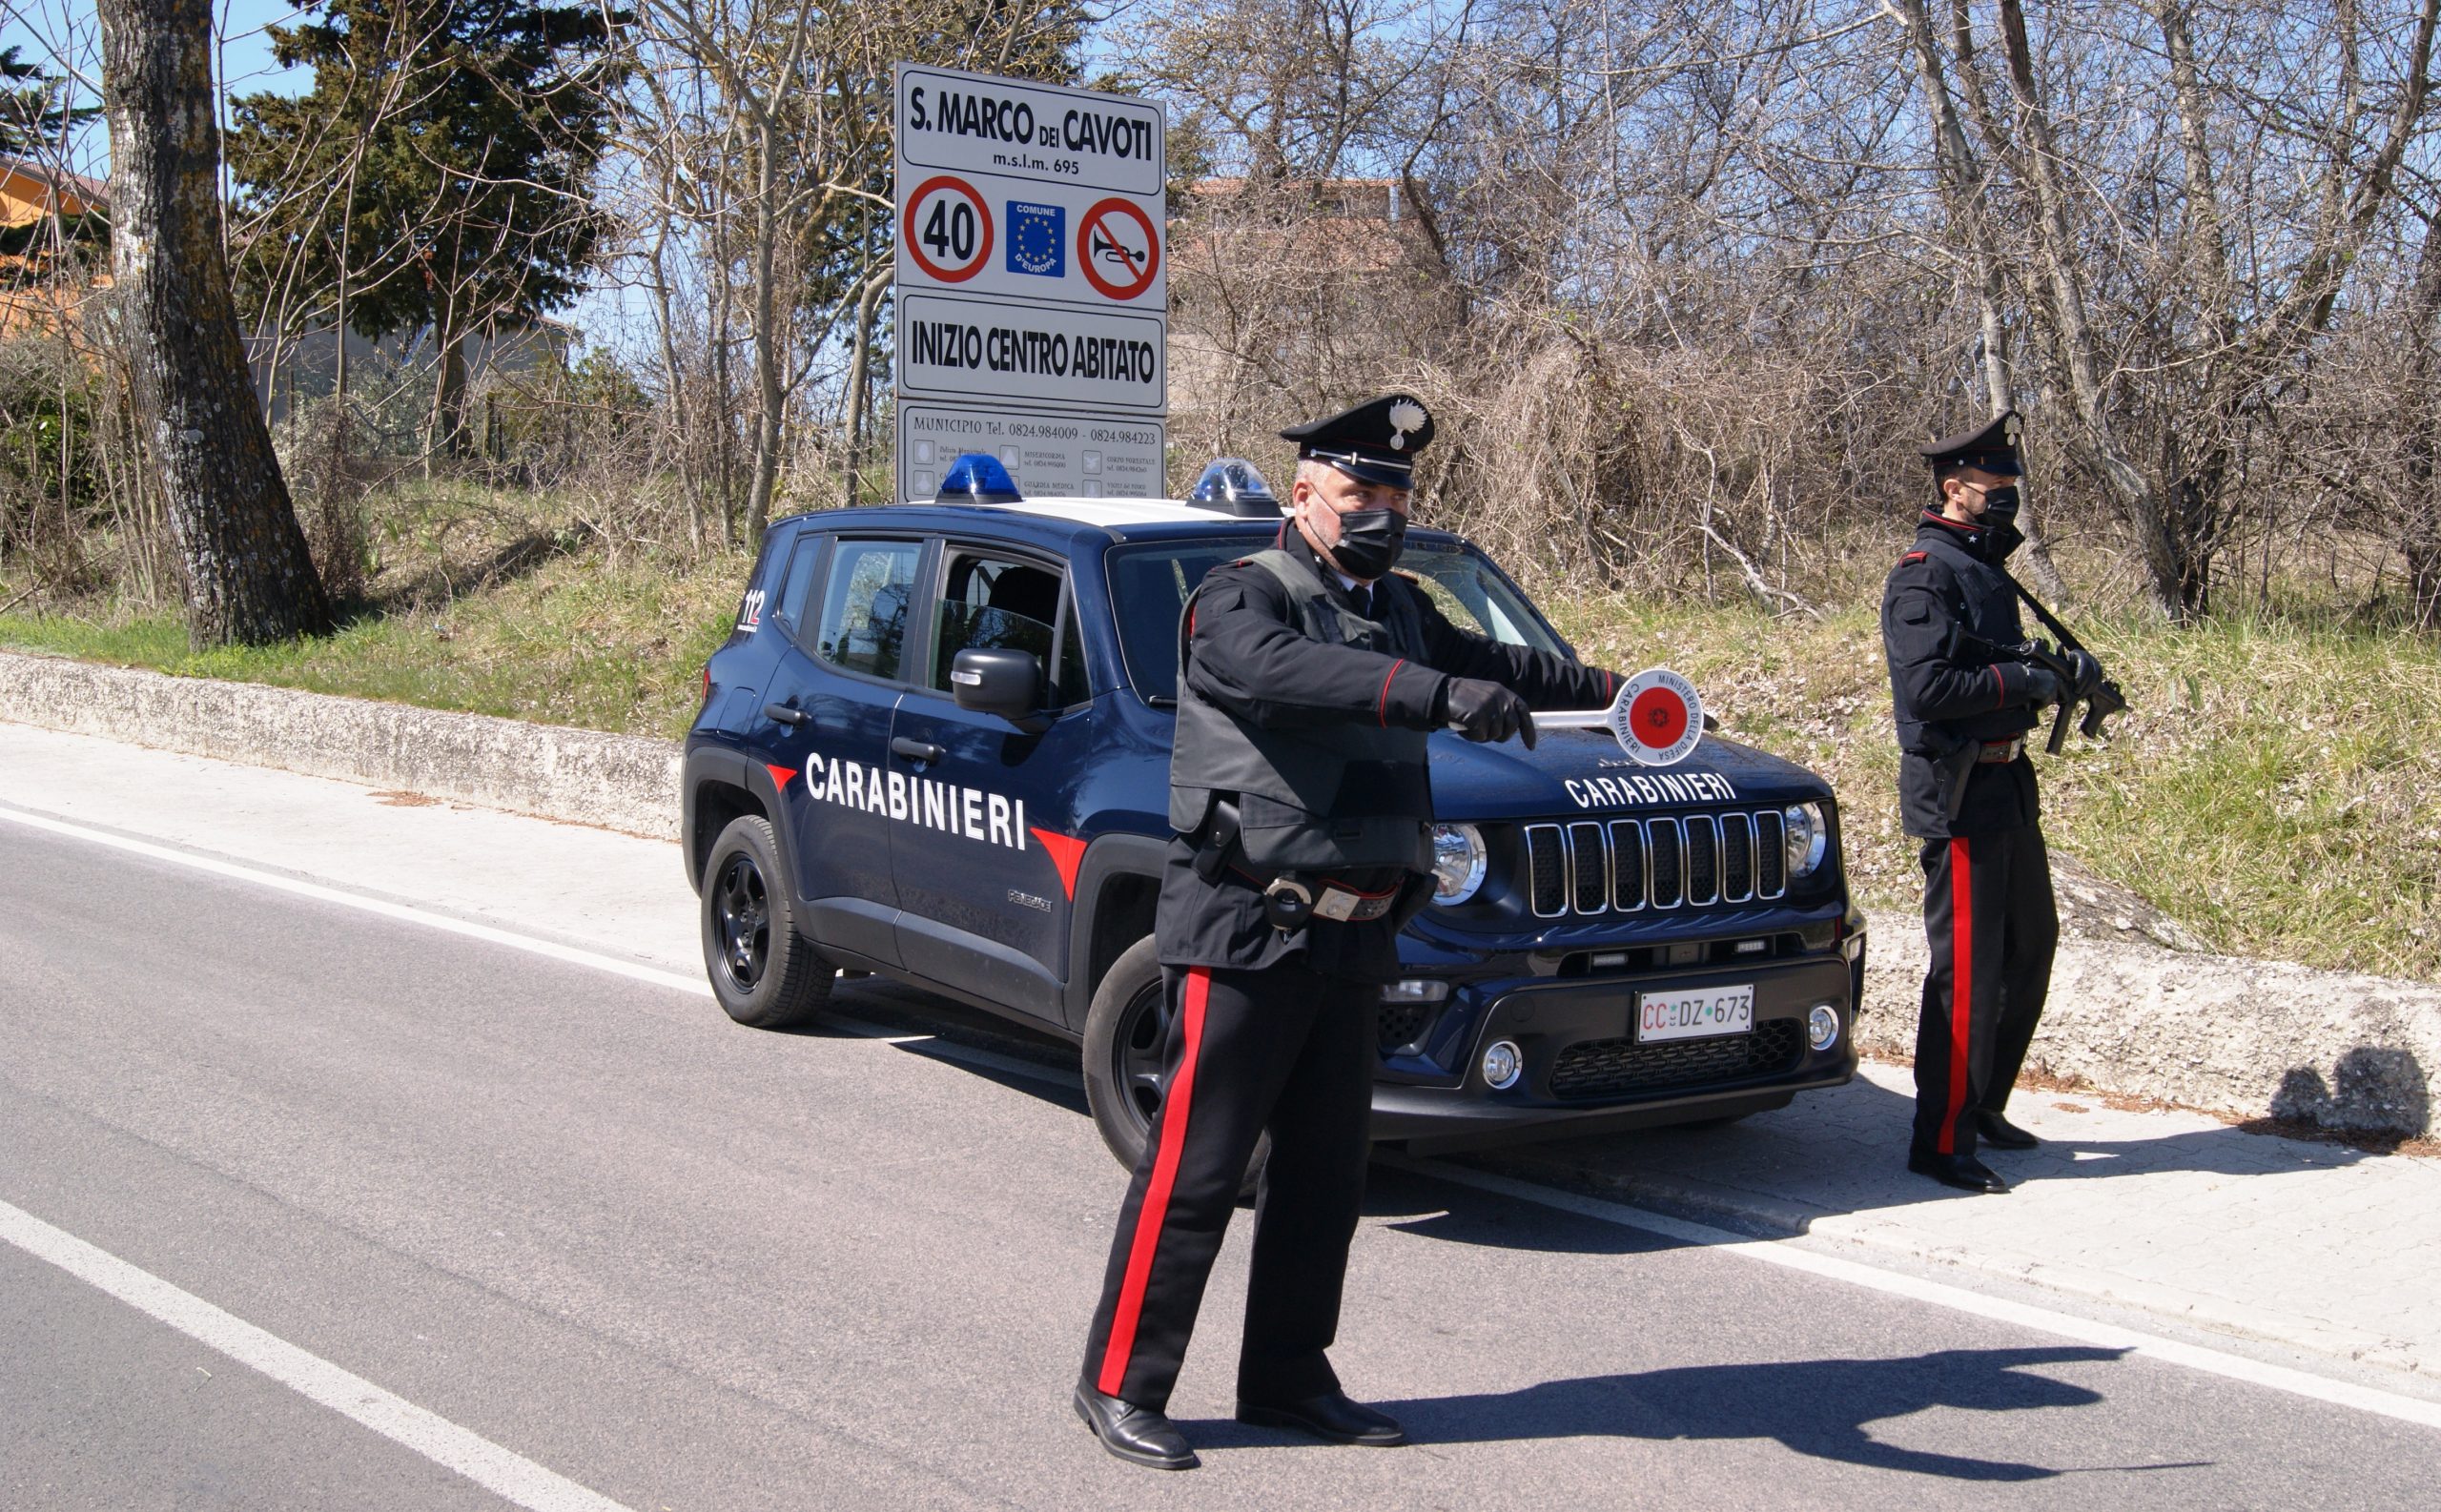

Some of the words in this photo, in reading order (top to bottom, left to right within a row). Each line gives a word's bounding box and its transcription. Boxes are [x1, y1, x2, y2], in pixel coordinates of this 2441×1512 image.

[911, 87, 932, 132] S.
[937, 91, 1035, 144] MARCO
[1039, 125, 1059, 148] DEI
[1063, 110, 1151, 161] CAVOTI
[994, 153, 1049, 172] m.s.l.m.
[1054, 160, 1079, 174] 695
[1016, 204, 1056, 217] COMUNE
[923, 199, 974, 260] 40
[1015, 253, 1057, 274] D'EUROPA
[912, 320, 982, 369] INIZIO
[987, 327, 1068, 377] CENTRO
[1072, 336, 1155, 384] ABITATO
[913, 417, 982, 434] MUNICIPIO
[986, 421, 1004, 436] Tel.
[1009, 423, 1078, 440] 0824.984009
[1090, 430, 1156, 445] 0824.984223
[1024, 450, 1065, 460] MISERICORDIA
[742, 589, 765, 625] 112
[1658, 674, 1697, 708] MINISTERO
[1618, 683, 1640, 754] CARABINIERI
[1686, 712, 1699, 740] DELLA
[1658, 742, 1688, 761] DIFESA
[806, 752, 1026, 850] CARABINIERI
[1565, 772, 1736, 808] CARABINIERI
[1008, 889, 1052, 913] RENEGADE
[1643, 1003, 1667, 1030] CC
[1679, 999, 1705, 1027] DZ
[1714, 995, 1751, 1023] 673
